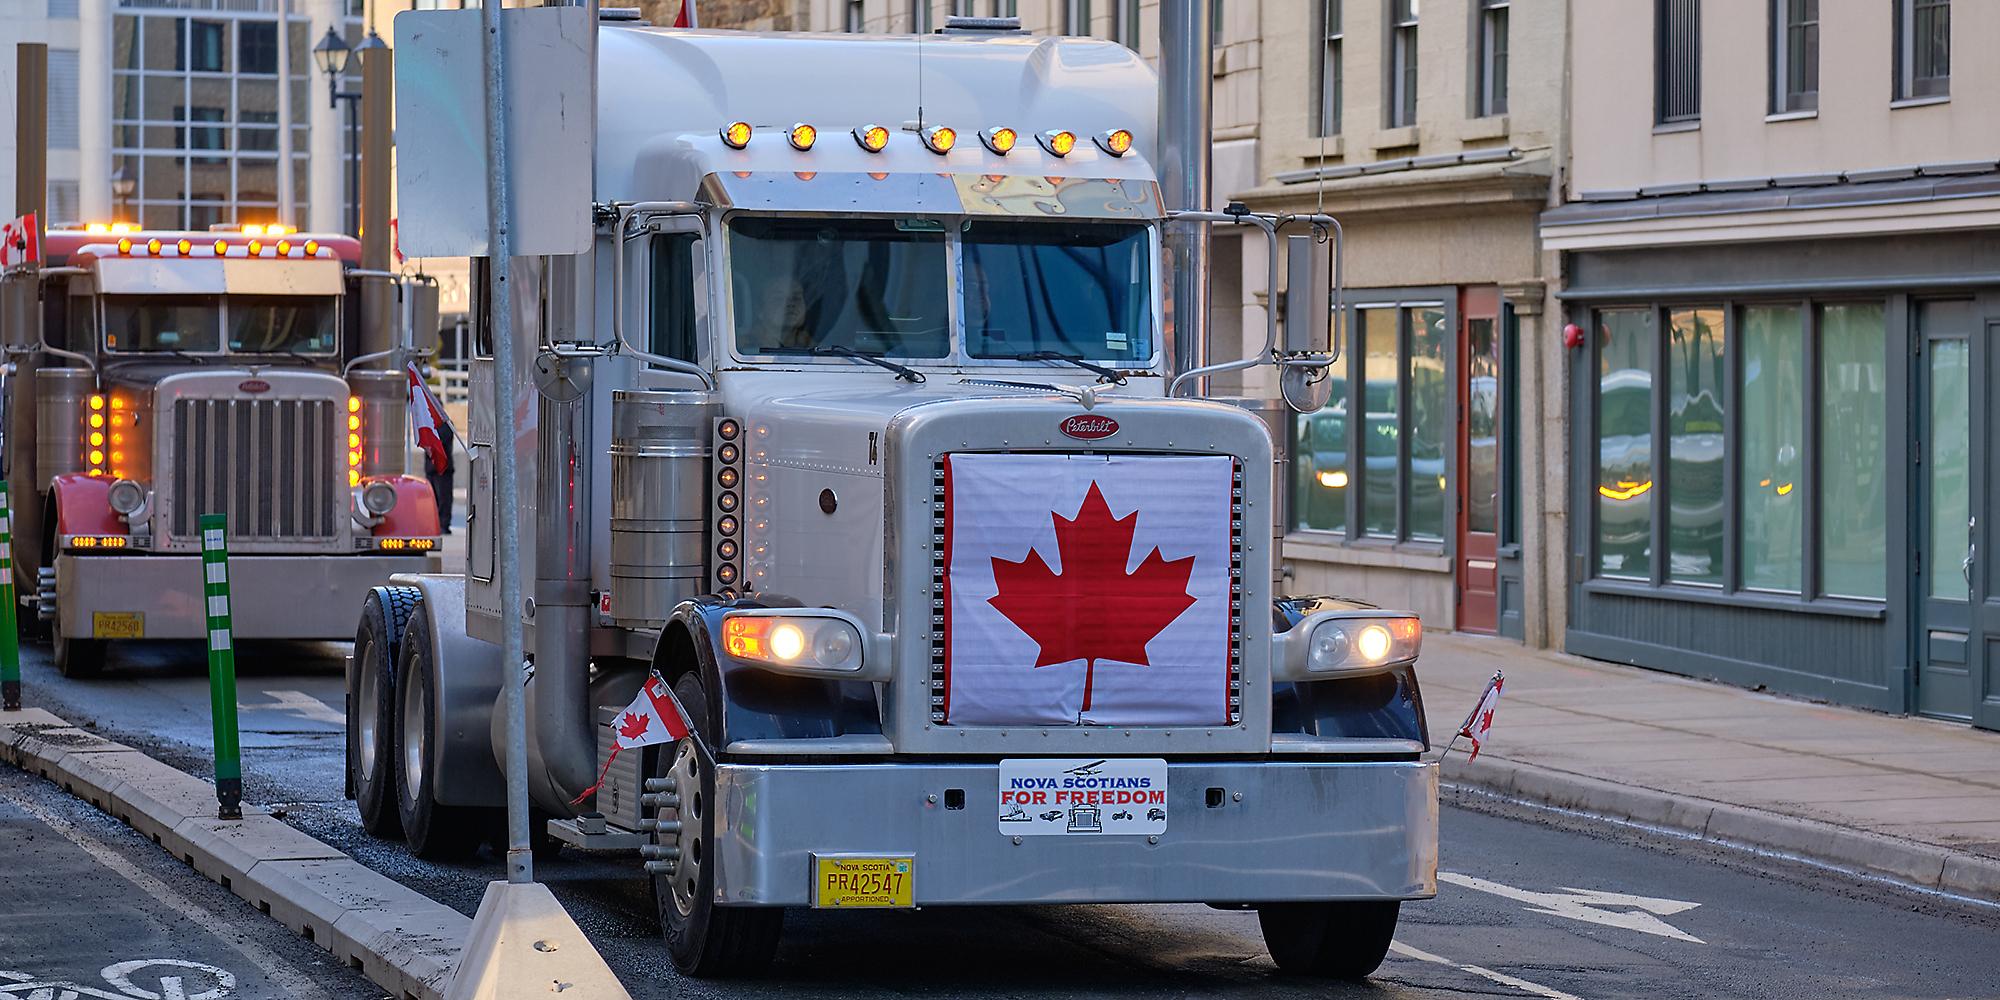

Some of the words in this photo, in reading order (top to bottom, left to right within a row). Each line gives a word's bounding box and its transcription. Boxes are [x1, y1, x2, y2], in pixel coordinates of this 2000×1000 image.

[1066, 418, 1114, 433] Peterbilt
[1010, 777, 1058, 789] NOVA
[1063, 777, 1151, 789] SCOTIANS
[1000, 791, 1047, 805] FOR
[1055, 791, 1166, 805] FREEDOM
[840, 863, 859, 871] NOVA
[862, 863, 890, 871] SCOTIA
[827, 873, 903, 894] PR42547
